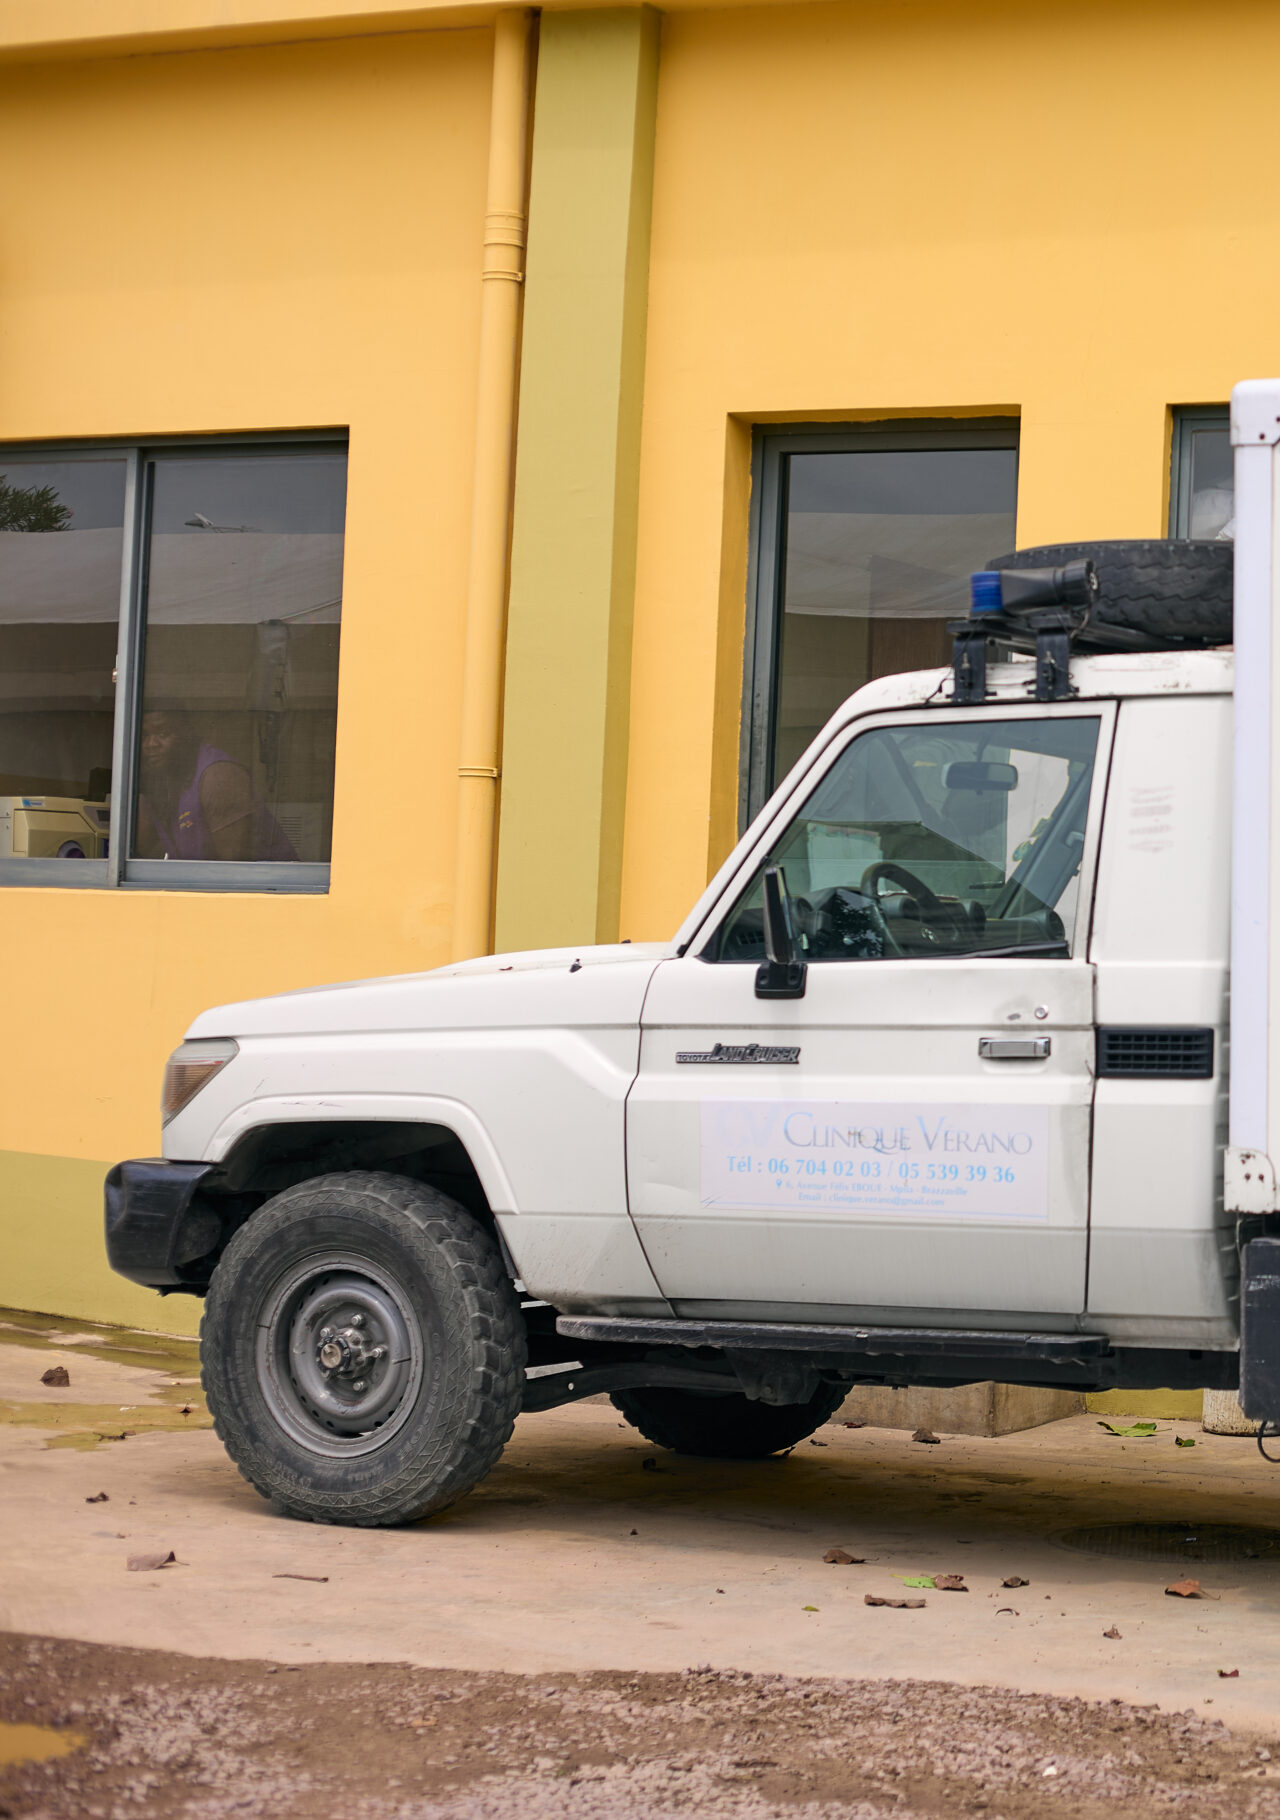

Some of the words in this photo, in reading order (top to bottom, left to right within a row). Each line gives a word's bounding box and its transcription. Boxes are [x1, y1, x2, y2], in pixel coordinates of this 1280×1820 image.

[782, 1111, 913, 1156] CLINIQUE
[728, 1156, 752, 1173] Tél
[767, 1157, 790, 1175] 06
[795, 1159, 827, 1176] 704
[832, 1160, 854, 1177] 02
[860, 1161, 881, 1178] 03
[898, 1161, 920, 1180] 05
[925, 1163, 959, 1181] 539
[965, 1164, 987, 1183] 39
[993, 1165, 1016, 1184] 36
